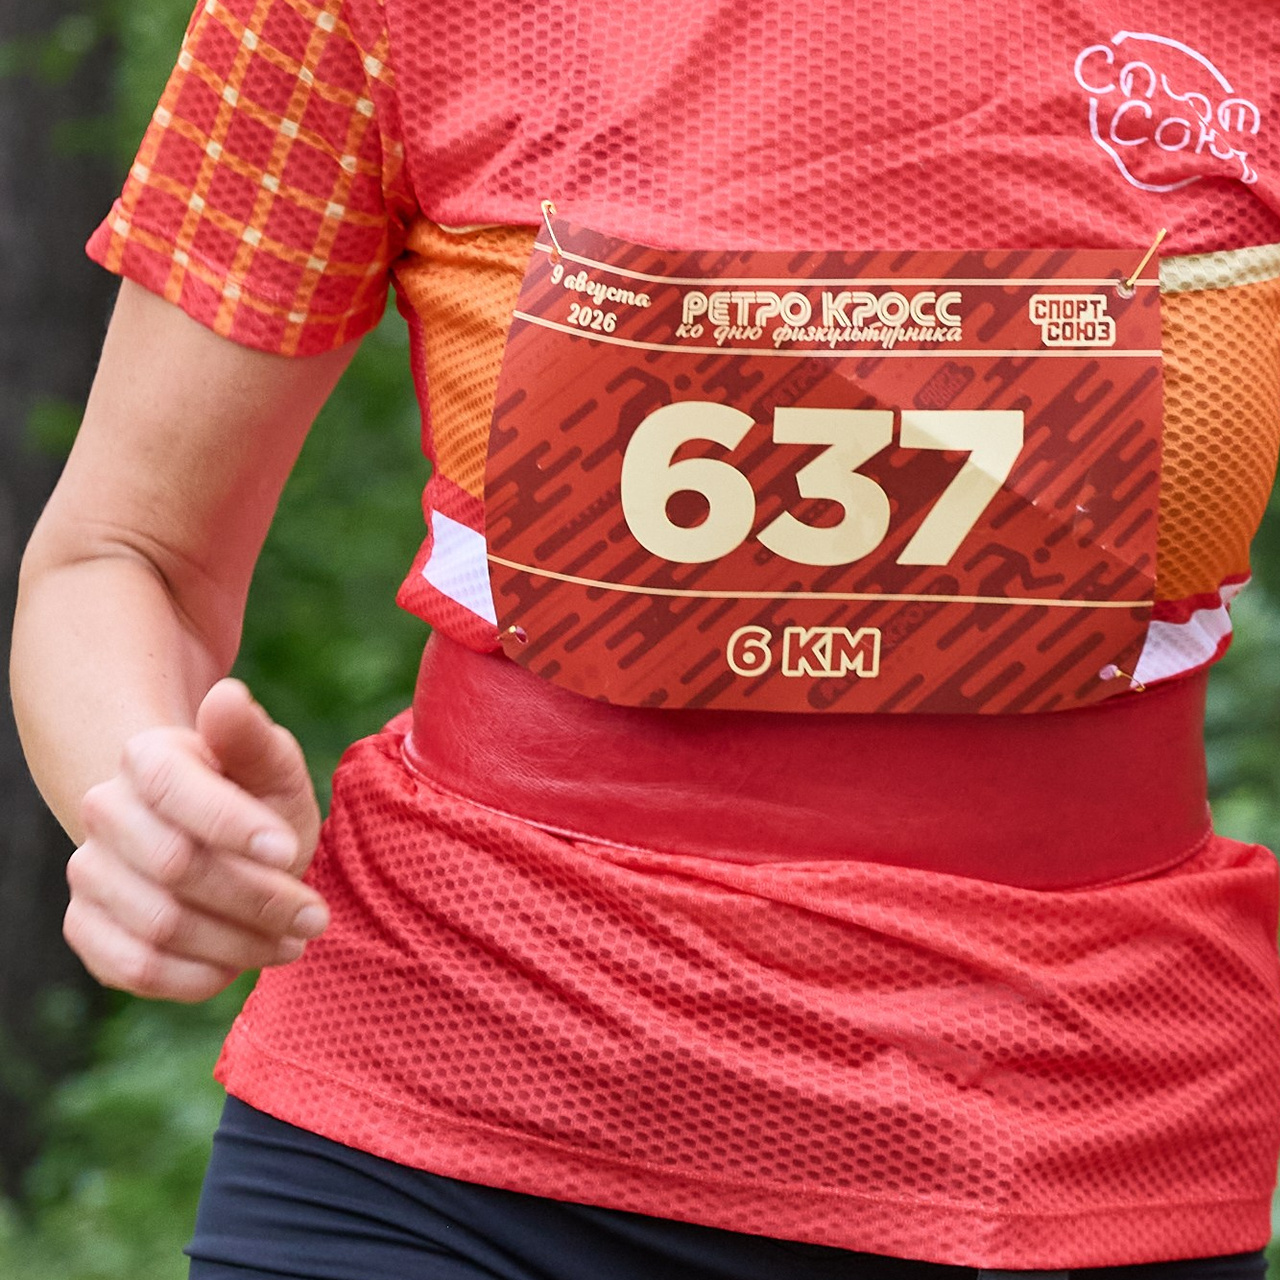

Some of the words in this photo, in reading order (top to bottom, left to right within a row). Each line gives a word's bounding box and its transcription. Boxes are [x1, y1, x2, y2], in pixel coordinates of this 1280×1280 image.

[551, 264, 564, 285] 9
[563, 271, 652, 308] августа
[567, 303, 617, 333] 2026
[682, 291, 812, 327] РЕТРО
[821, 291, 962, 327] КРОСС
[1034, 299, 1102, 320] СПОРТ
[675, 322, 704, 339] ко
[713, 326, 763, 347] дню
[1046, 320, 1111, 341] СОЮЗ
[620, 400, 1025, 568] 637
[727, 625, 772, 677] 6
